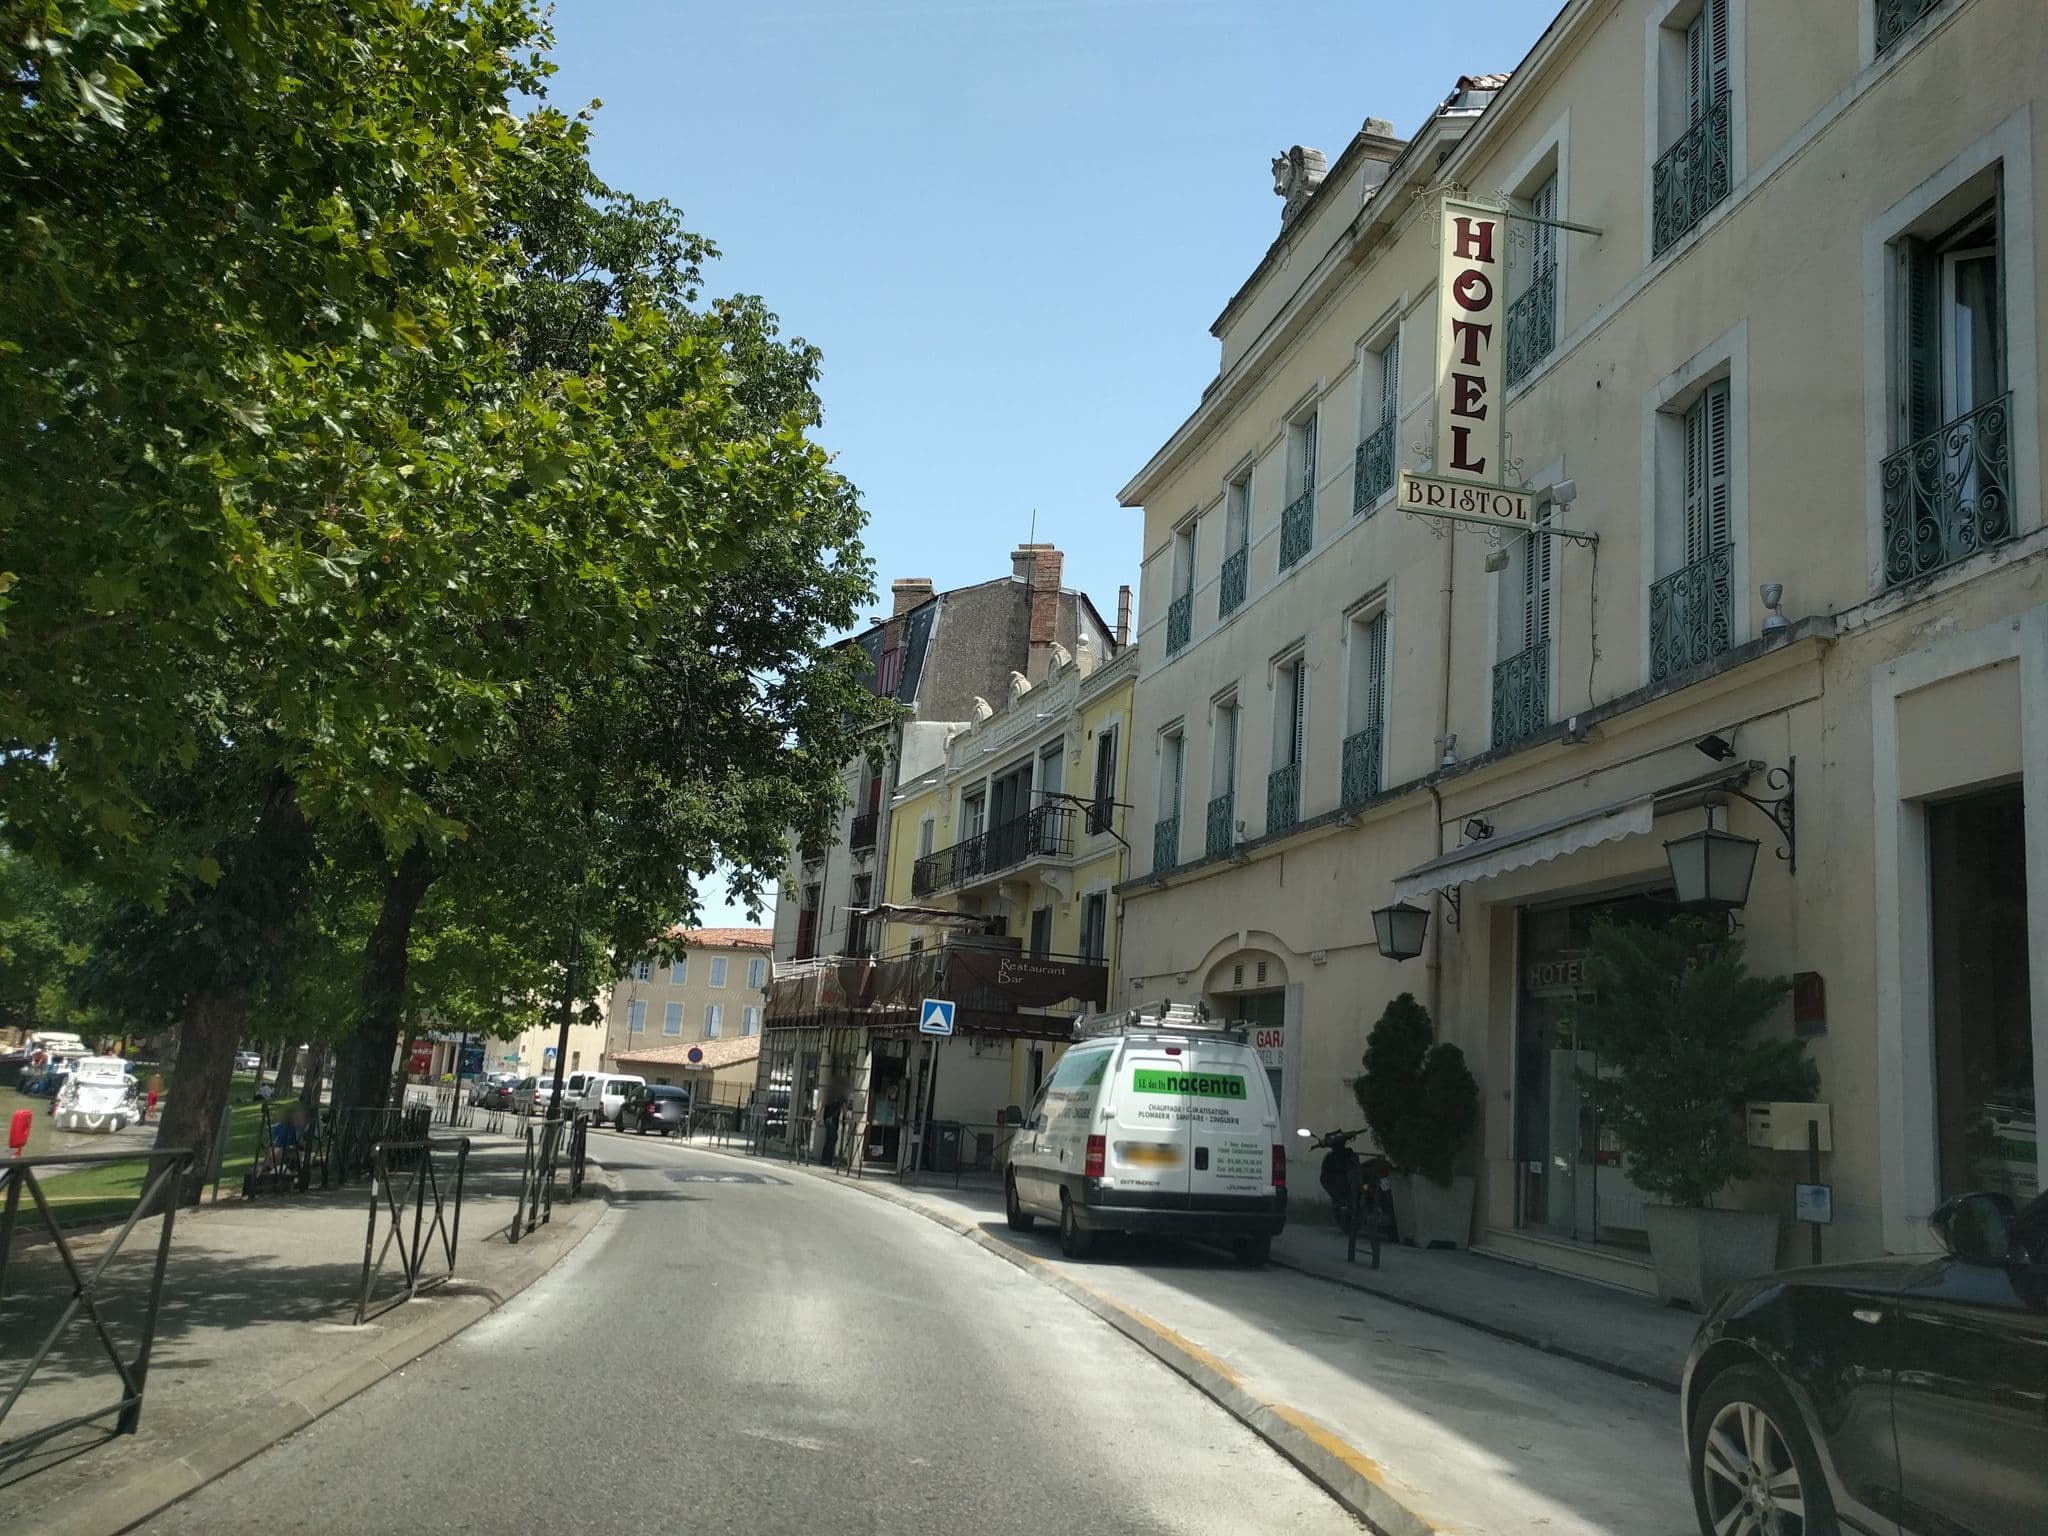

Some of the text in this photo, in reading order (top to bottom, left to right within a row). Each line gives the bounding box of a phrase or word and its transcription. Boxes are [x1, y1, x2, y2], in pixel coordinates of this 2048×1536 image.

[1449, 217, 1496, 475] HOTEL
[1407, 481, 1527, 521] BRISTOL
[1000, 958, 1067, 976] Restaurant
[998, 971, 1024, 984] Bar
[1138, 1111, 1171, 1120] PLOMBERIE
[1148, 1104, 1181, 1113] CHAUFFAGE
